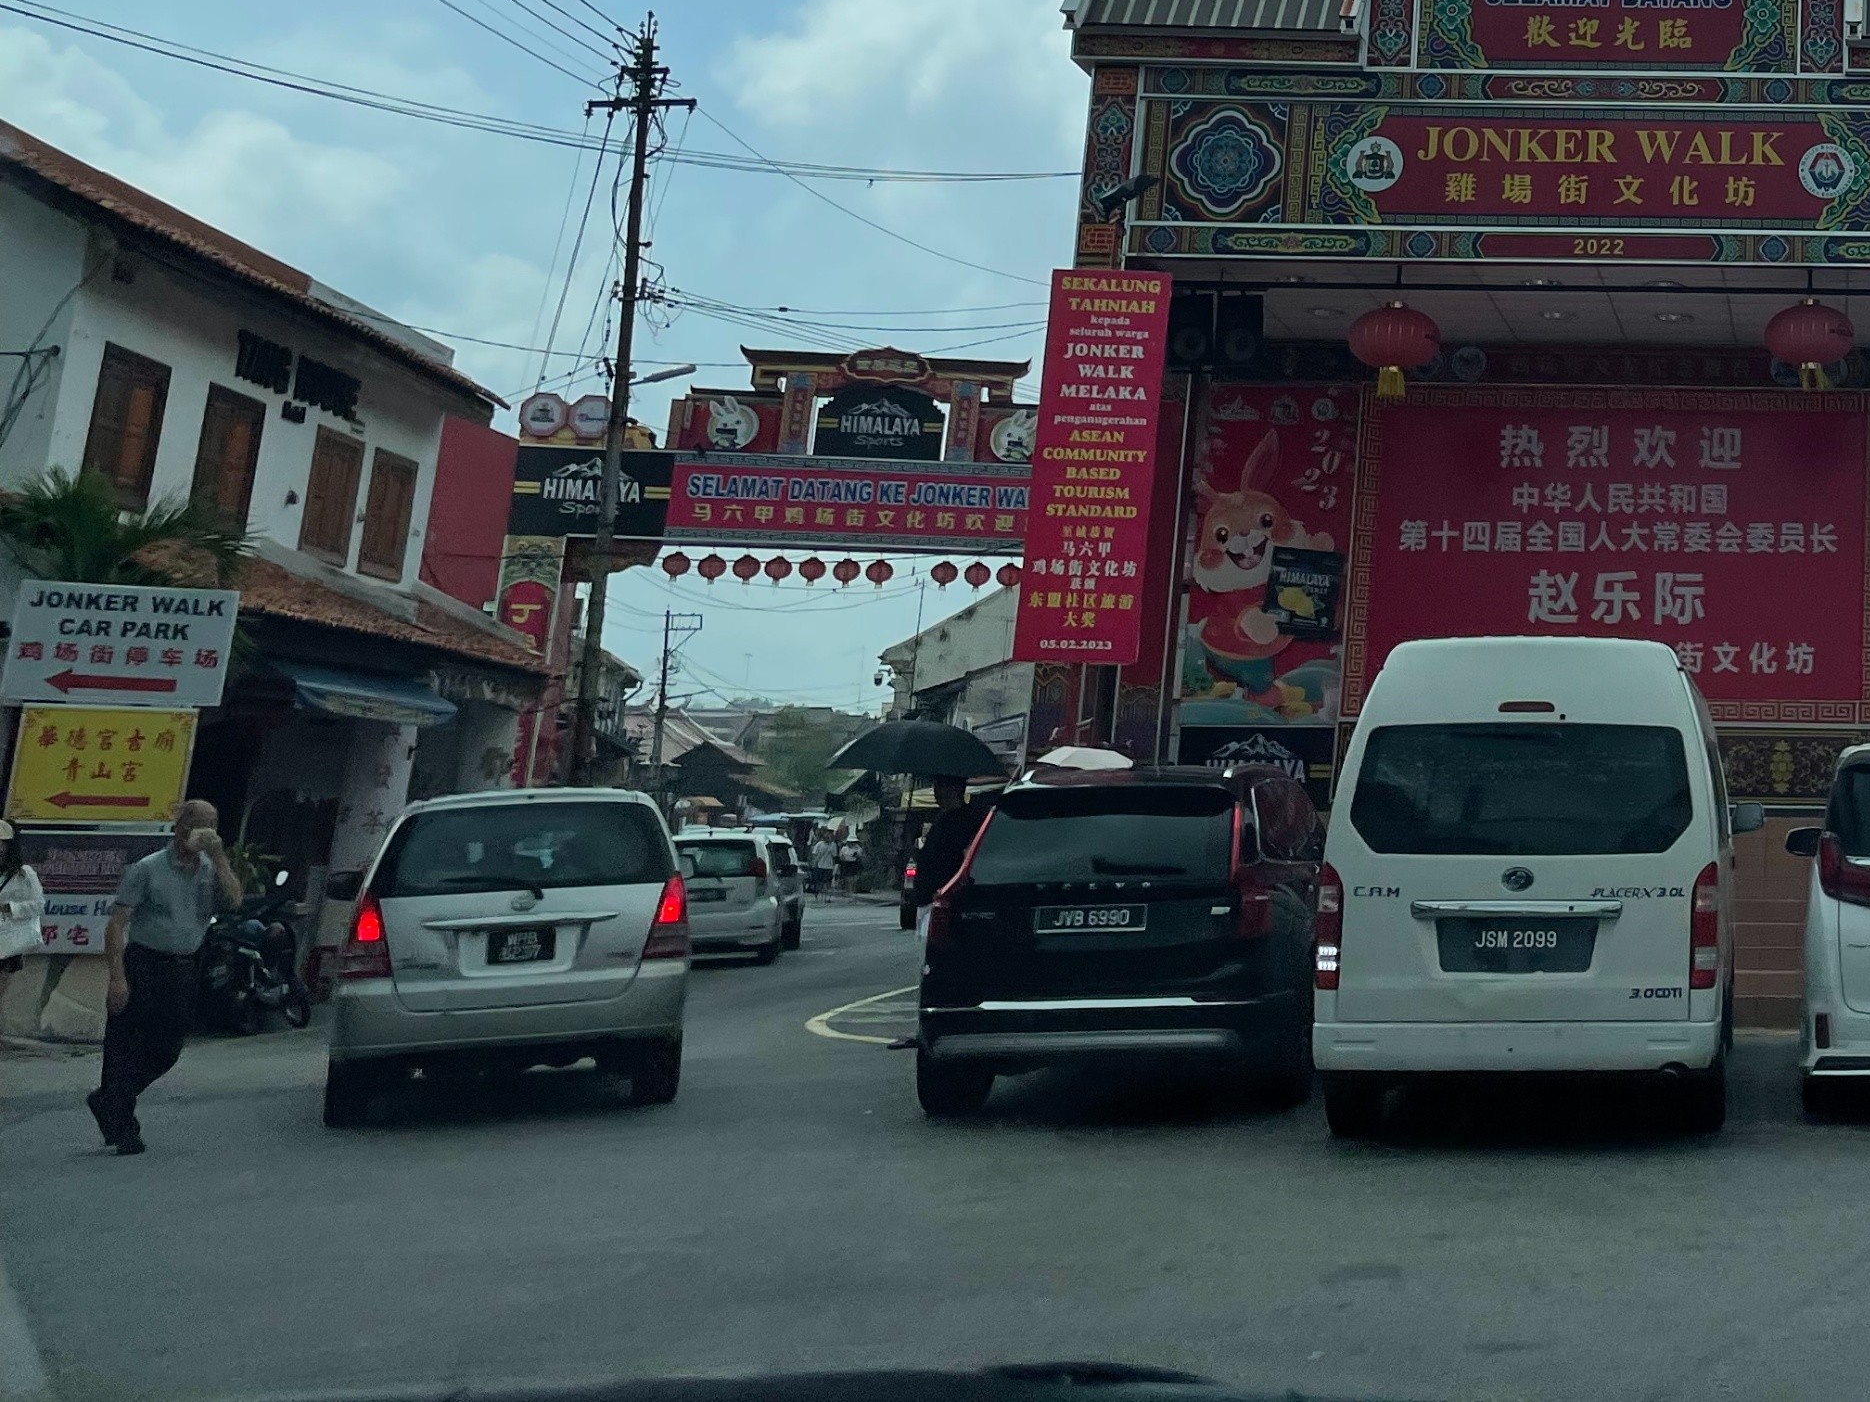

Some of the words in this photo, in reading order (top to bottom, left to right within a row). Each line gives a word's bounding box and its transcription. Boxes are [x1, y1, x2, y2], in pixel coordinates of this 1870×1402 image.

[1417, 125, 1617, 164] JONKER
[1635, 130, 1785, 167] WALK
[1445, 171, 1756, 206] 雞場街文化坊
[1573, 238, 1625, 256] 2022
[1061, 276, 1161, 294] SEKALUNG
[1068, 297, 1156, 314] TAHNIAH
[1090, 314, 1130, 327] kepada
[1115, 328, 1149, 341] warga
[1063, 342, 1145, 360] JONKER
[1078, 363, 1134, 379] WALK
[1059, 383, 1147, 400] MELAKA
[1089, 402, 1112, 412] atas
[840, 414, 921, 436] HIMALAYA
[854, 434, 904, 449] Sports
[1068, 429, 1125, 444] ASEAN
[1042, 447, 1148, 464] COMMUNITY
[1499, 424, 1743, 470] 热烈欢迎
[1066, 466, 1121, 481] BASED
[543, 477, 640, 503] HIMAYA
[687, 473, 784, 499] SELAMAT
[788, 477, 872, 505] DATANG
[877, 481, 906, 505] KE
[908, 483, 990, 507] JONKER
[997, 485, 1030, 509] WA
[1053, 484, 1130, 499] TOURISM
[1511, 483, 1729, 515] 中华人民共和国
[692, 503, 1029, 533] 马六甲鸡场街文化坊欢迎
[1045, 503, 1138, 519] STANDARD
[1399, 520, 1838, 554] 第十四届全国人大常委会委员长
[1061, 541, 1112, 558] 马六甲
[1031, 559, 1138, 578] 鸡场街文化坊
[30, 591, 139, 613] JONKER
[151, 596, 226, 618] WALK
[1528, 570, 1706, 625] 赵乐际
[59, 618, 112, 638] CAR
[120, 620, 190, 641] PARK
[1039, 638, 1113, 651] 05.02.2023
[1656, 886, 1685, 897] 3.0L
[1474, 931, 1508, 948] JSM
[1512, 930, 1557, 948] 2099
